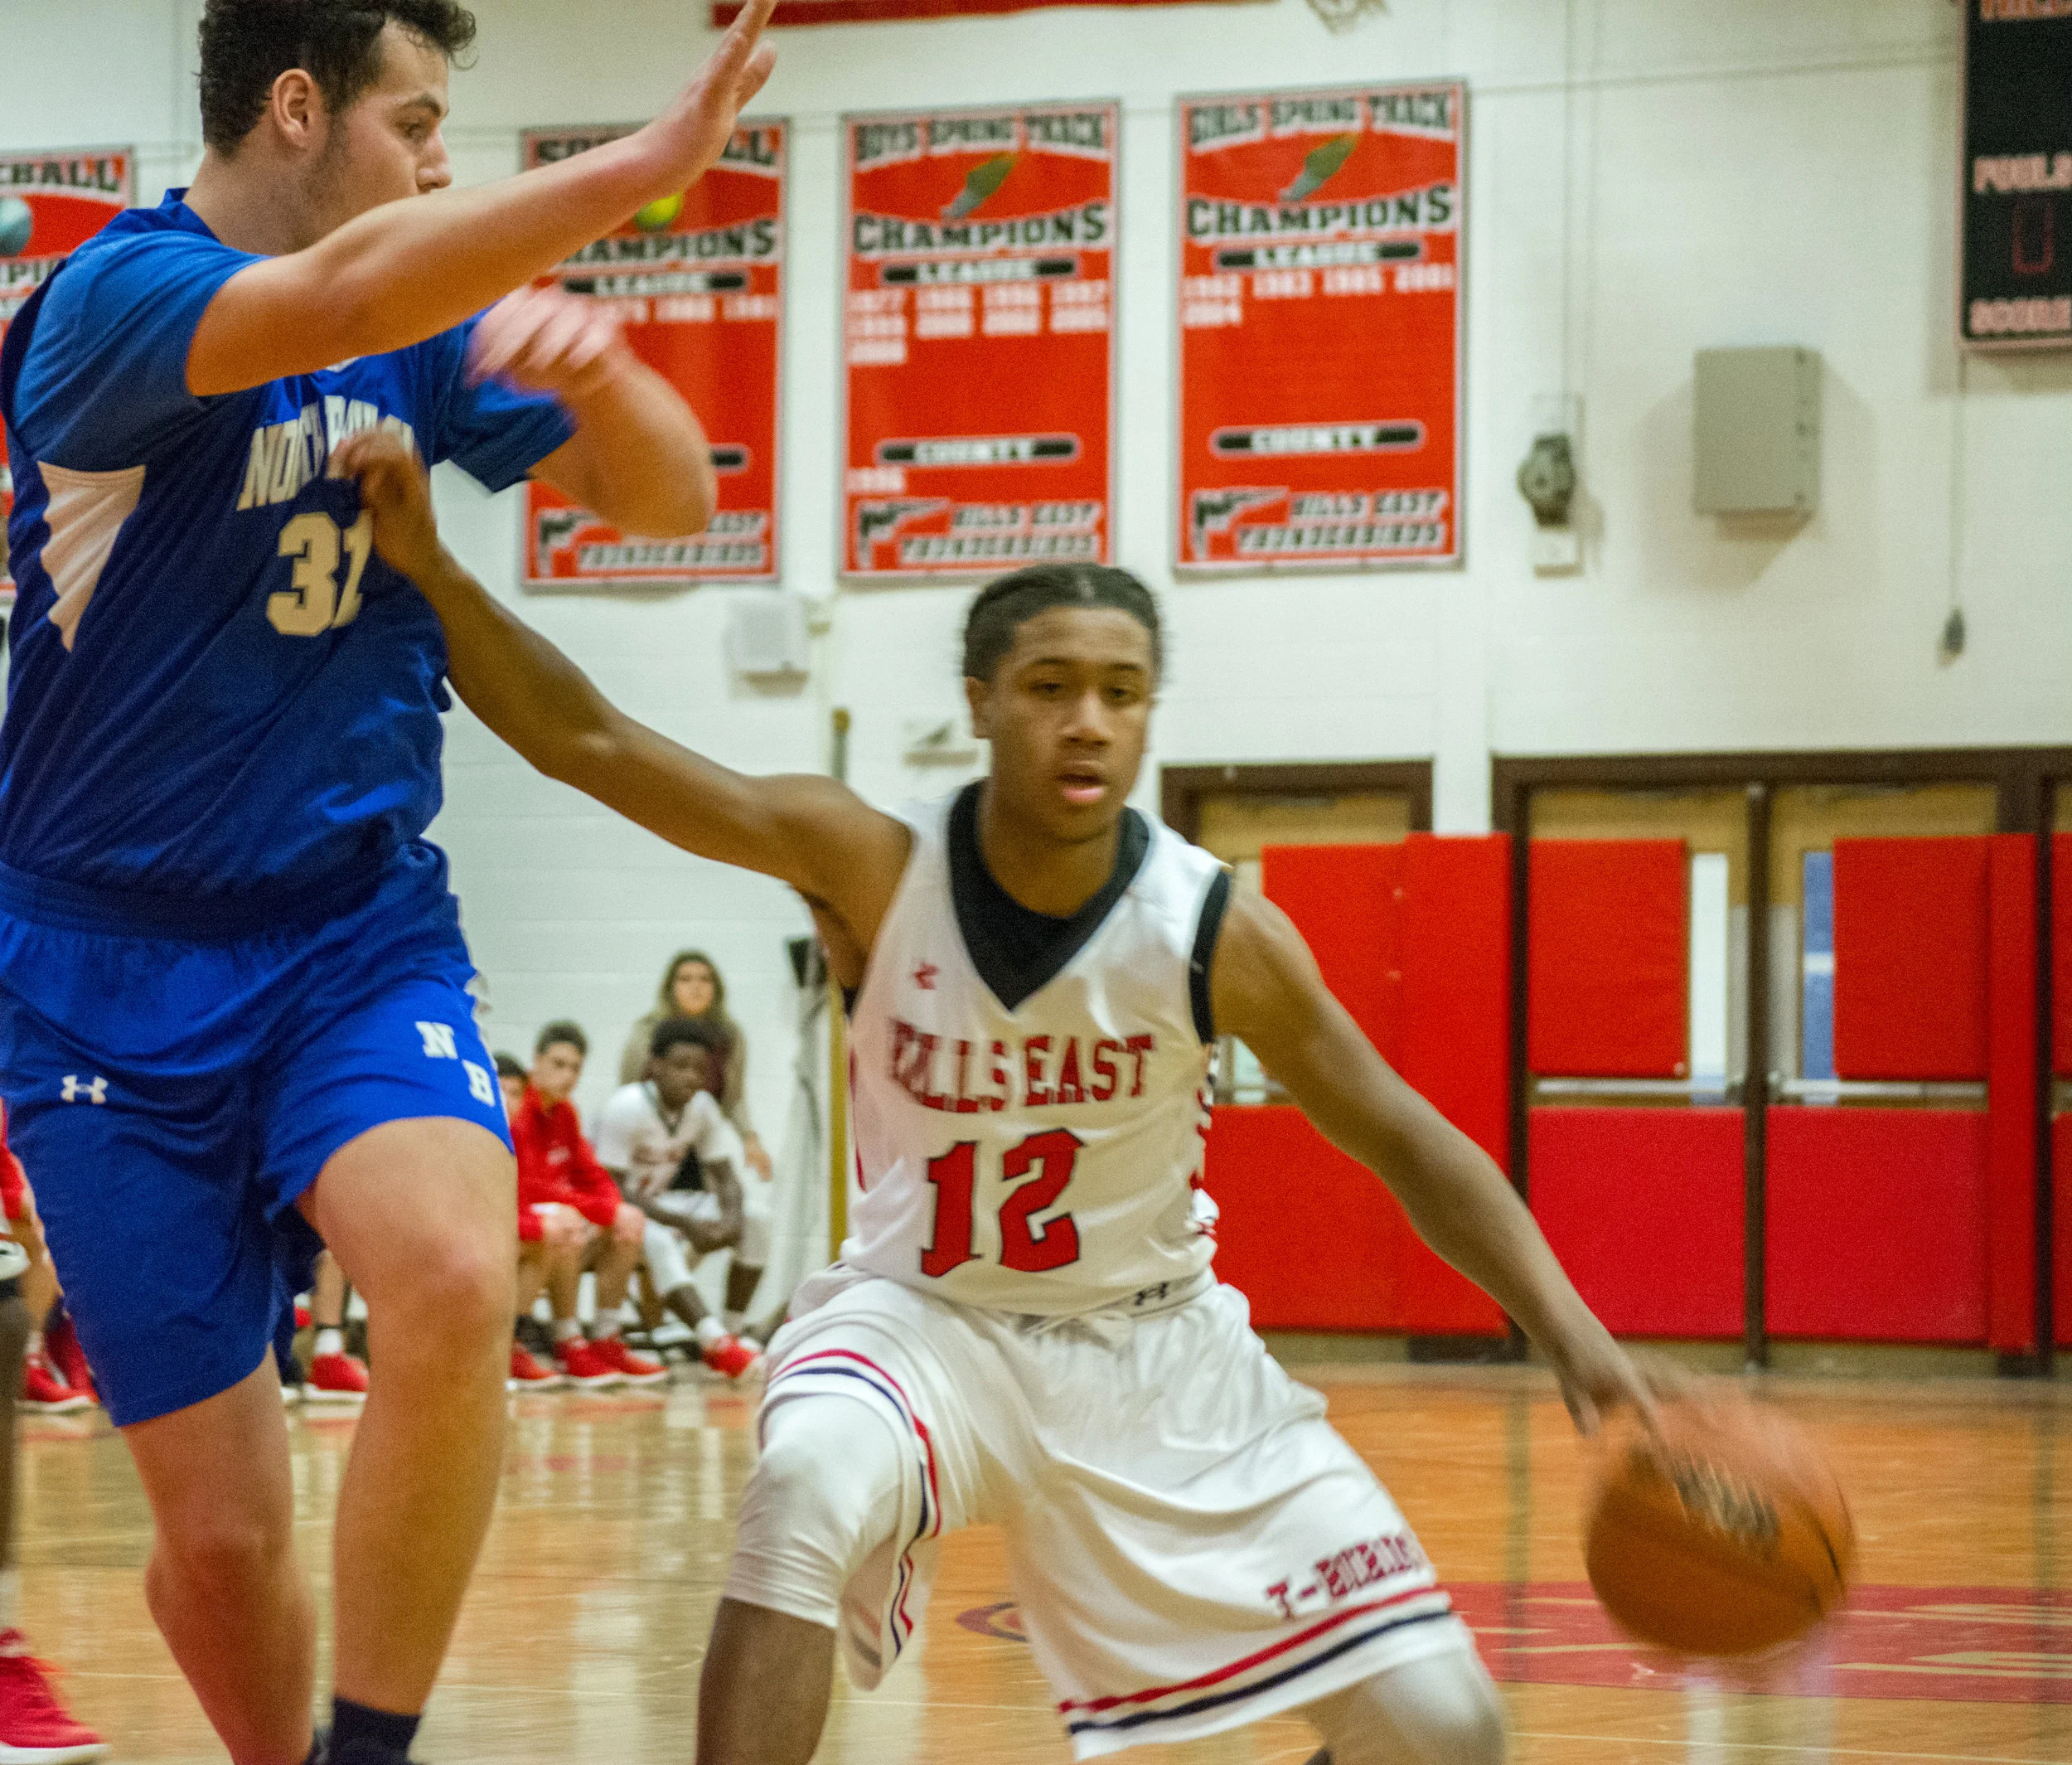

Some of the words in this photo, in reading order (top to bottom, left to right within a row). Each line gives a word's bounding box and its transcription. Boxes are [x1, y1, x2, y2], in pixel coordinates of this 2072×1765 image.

[854, 204, 1107, 254] CHAMPIONS
[1187, 184, 1452, 237] CHAMPIONS
[564, 219, 777, 264] AMPIONS
[265, 511, 373, 638] 31
[415, 1021, 458, 1059] N
[462, 1059, 496, 1108] B
[1024, 1033, 1159, 1108] EAST
[921, 1127, 1088, 1278] 12
